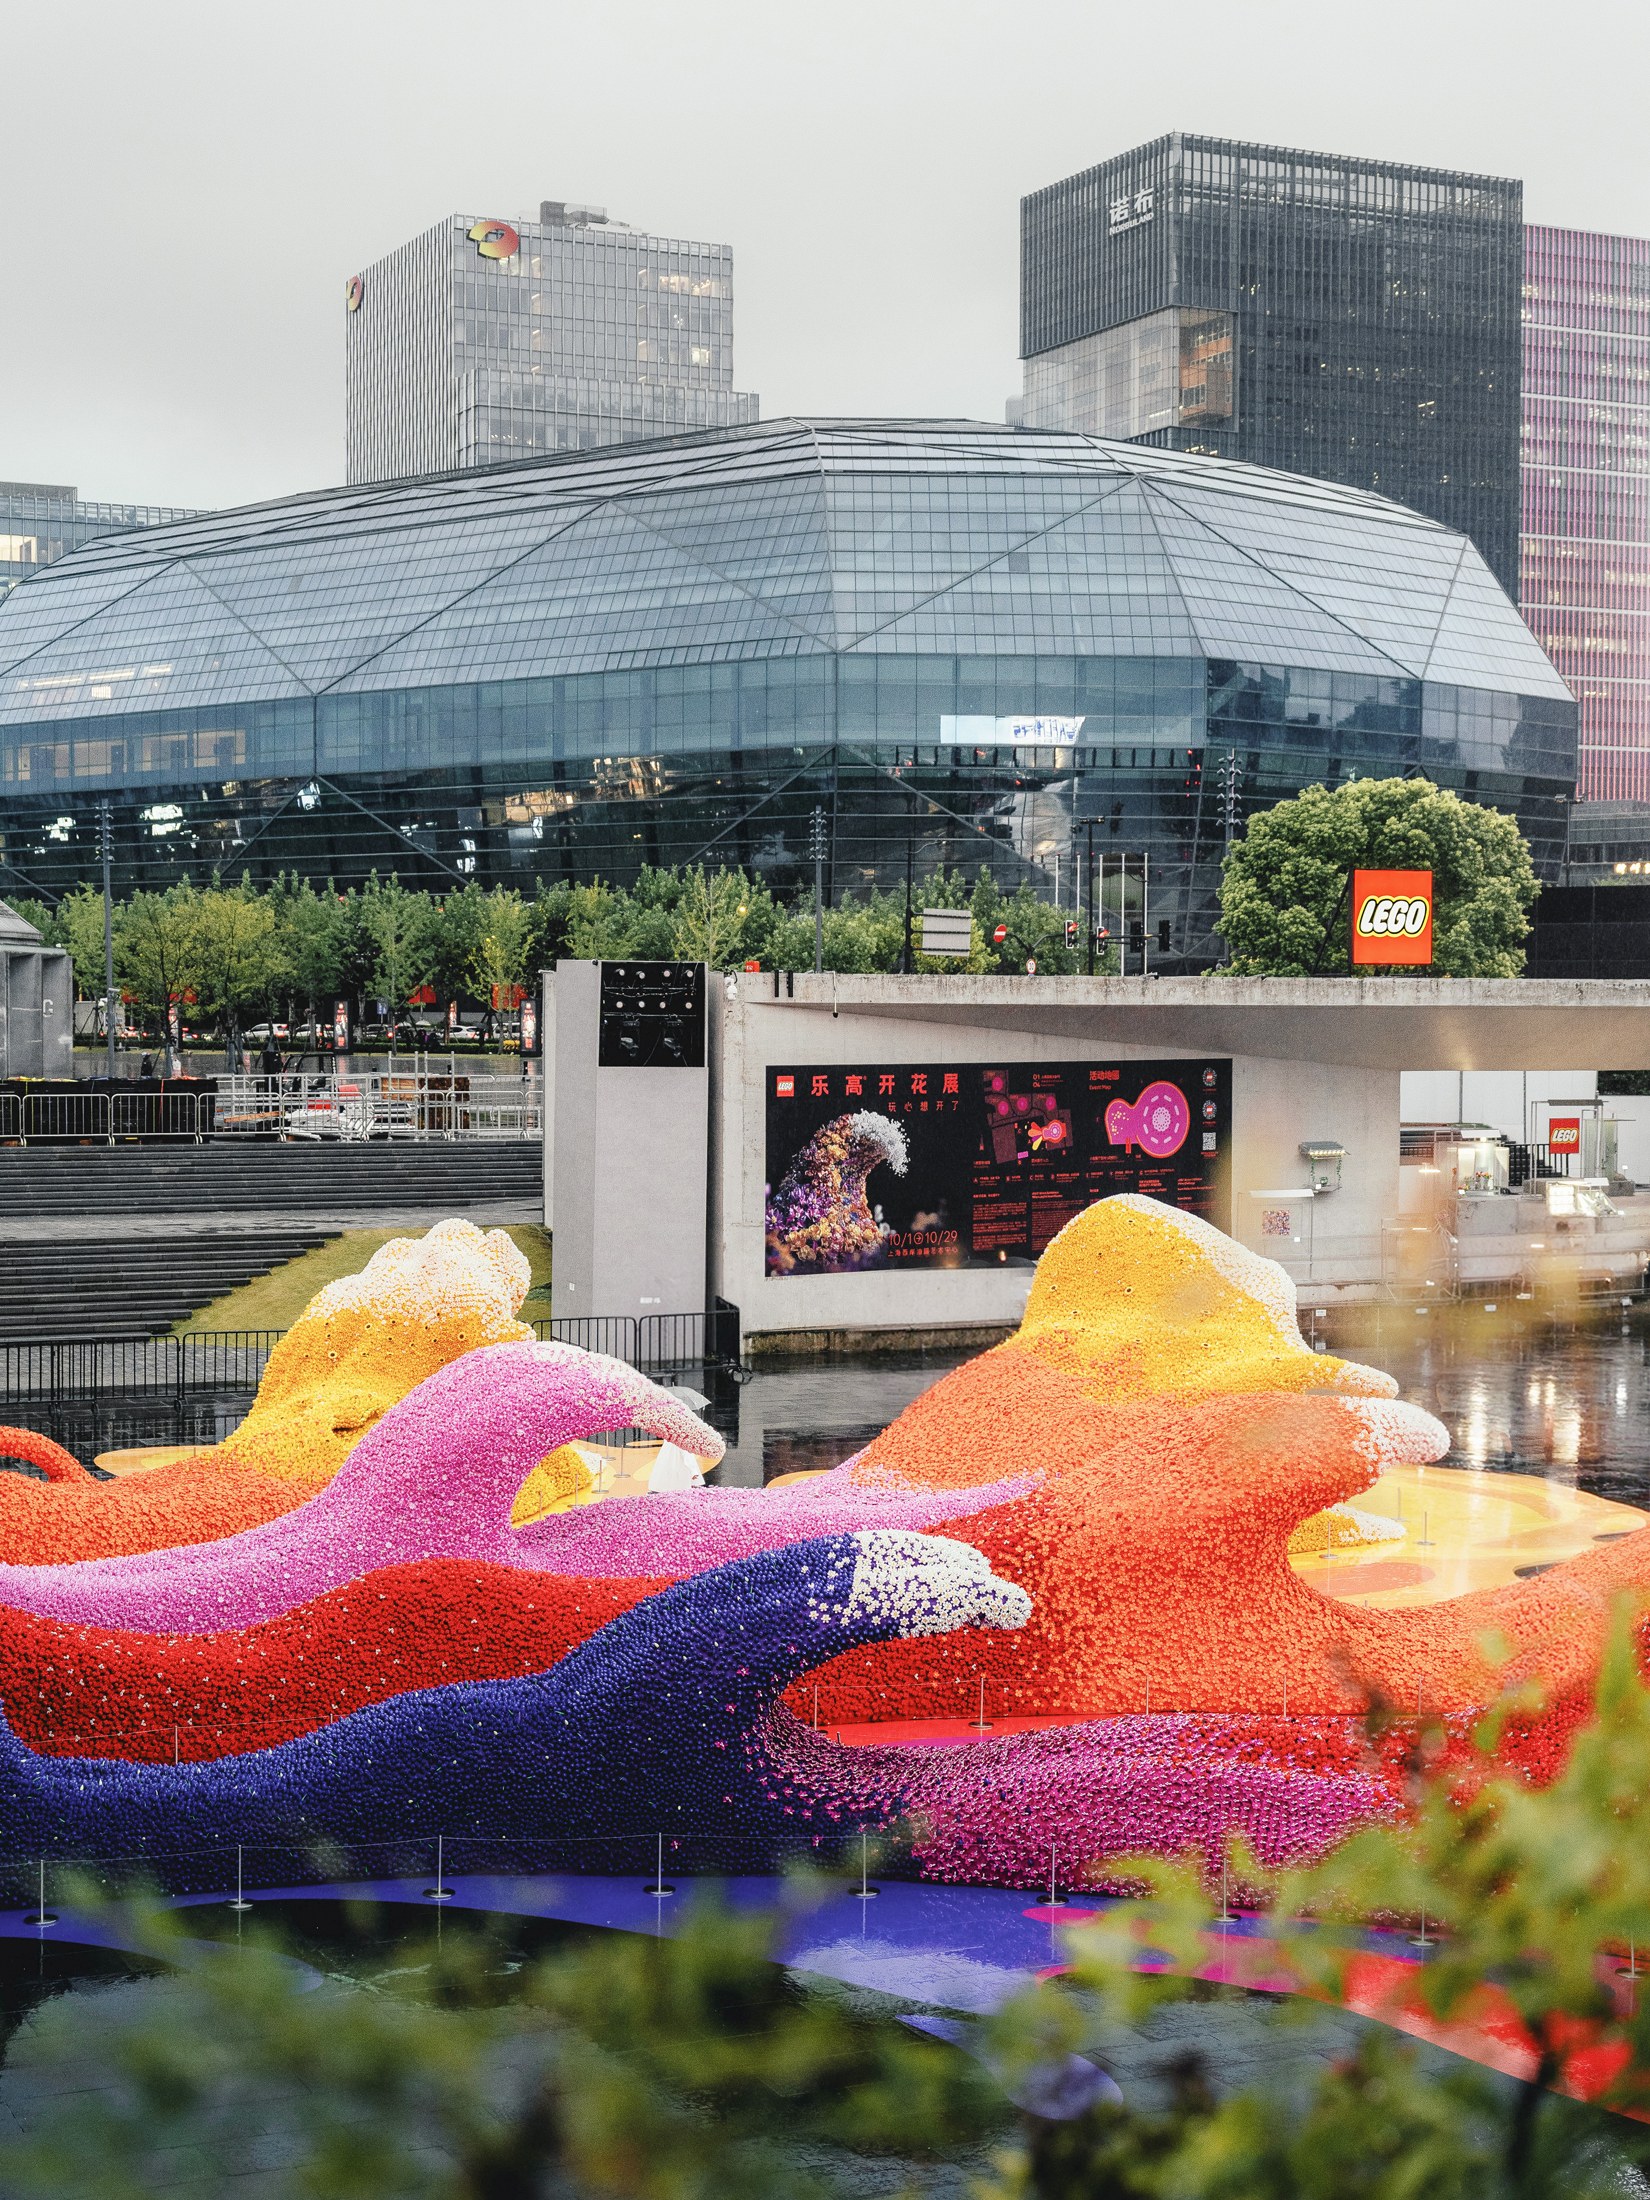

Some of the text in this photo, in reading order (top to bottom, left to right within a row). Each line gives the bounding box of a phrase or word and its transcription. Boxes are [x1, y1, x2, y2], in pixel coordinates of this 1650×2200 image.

[1110, 187, 1154, 224] 诺布
[1110, 212, 1154, 236] NORBULAND
[1358, 897, 1429, 936] LEGO
[43, 999, 53, 1018] G
[1089, 1069, 1120, 1081] 活动地图
[777, 1081, 793, 1091] LEGO
[888, 1100, 959, 1113] 玩心想开了
[1552, 1128, 1578, 1143] LEGO
[888, 1232, 912, 1248] 10/1
[925, 1230, 958, 1246] 10/29
